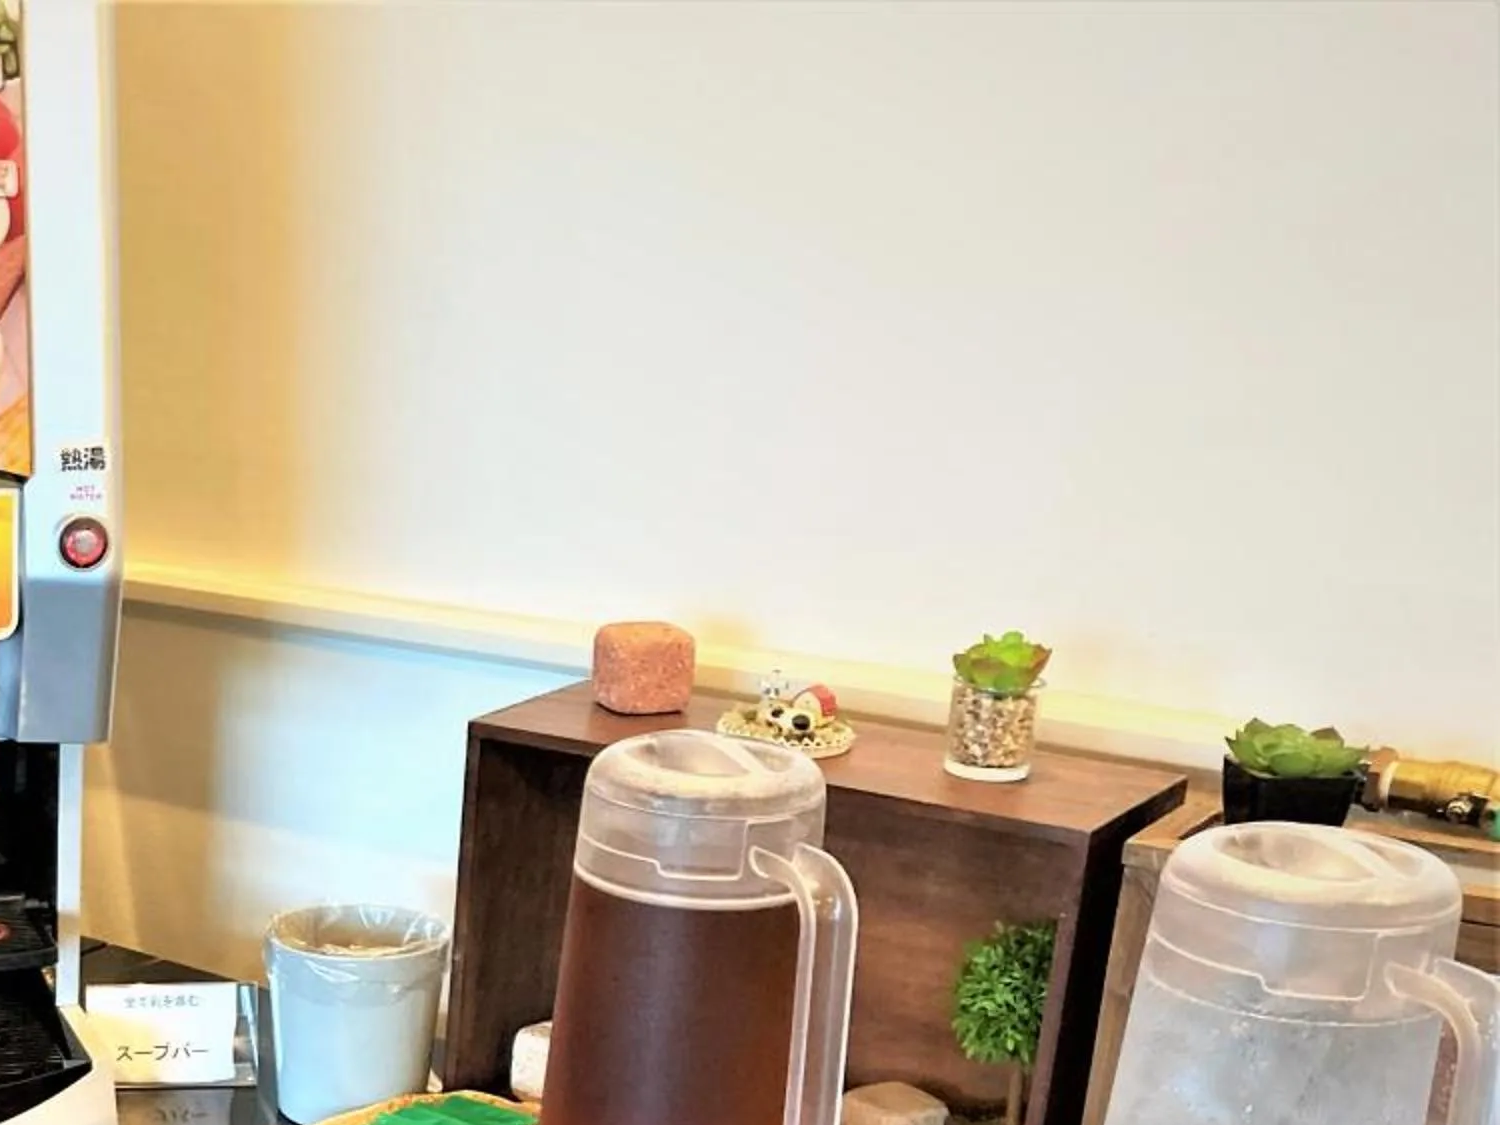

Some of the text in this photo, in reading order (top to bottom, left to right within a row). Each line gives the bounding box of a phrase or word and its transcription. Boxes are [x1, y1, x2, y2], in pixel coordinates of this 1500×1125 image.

[60, 446, 106, 472] 熱湯
[115, 1041, 209, 1062] スープバー
